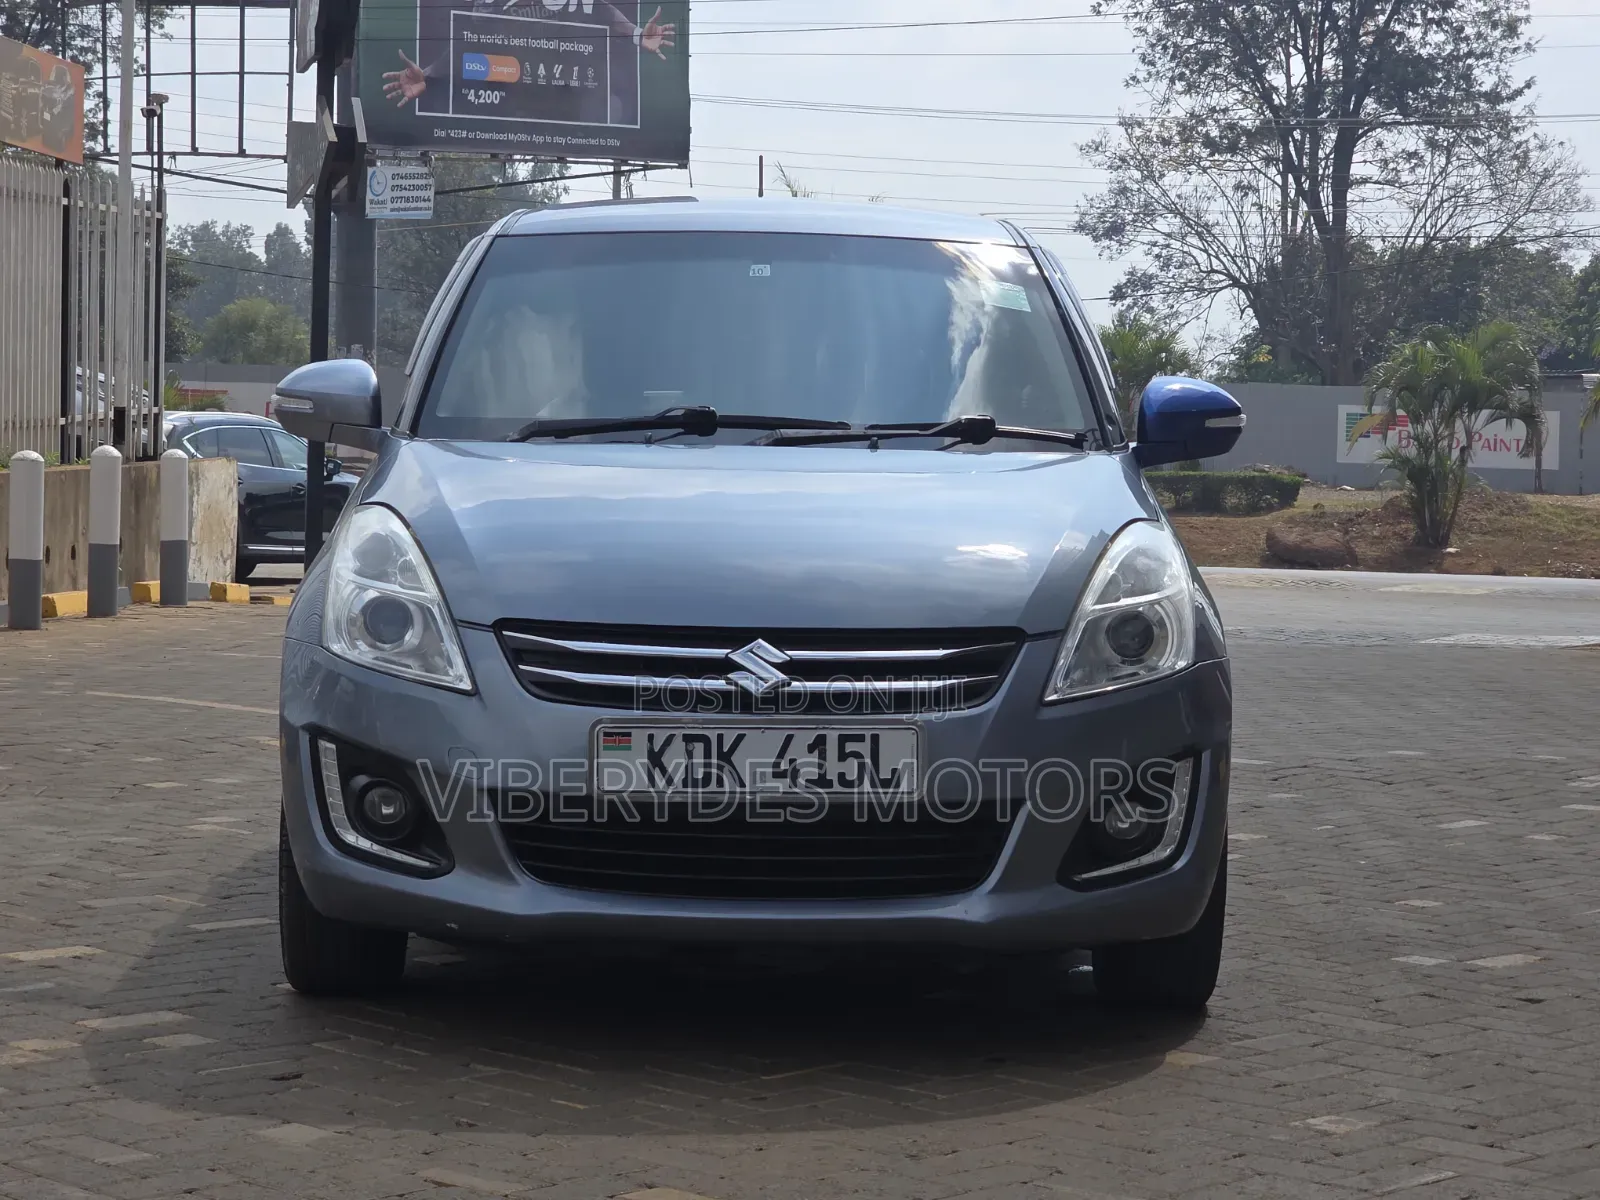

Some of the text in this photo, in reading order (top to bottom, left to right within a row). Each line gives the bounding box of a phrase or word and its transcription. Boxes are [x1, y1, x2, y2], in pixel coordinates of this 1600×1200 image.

[463, 31, 594, 55] The world's best football package
[465, 62, 517, 75] DStv Compact
[467, 88, 500, 105] 4,200
[433, 128, 447, 138] Dial
[468, 131, 475, 139] or
[476, 131, 507, 140] Download
[508, 132, 531, 143] MyDStv
[532, 134, 545, 144] App
[545, 135, 552, 143] to
[553, 135, 566, 146] stay
[566, 136, 599, 145] Connected
[599, 137, 607, 146] to
[607, 138, 621, 146] DStv
[390, 184, 432, 192] 0754230057
[390, 195, 431, 204] 0771830144
[647, 733, 747, 789] KDK
[771, 733, 899, 789] 415L
